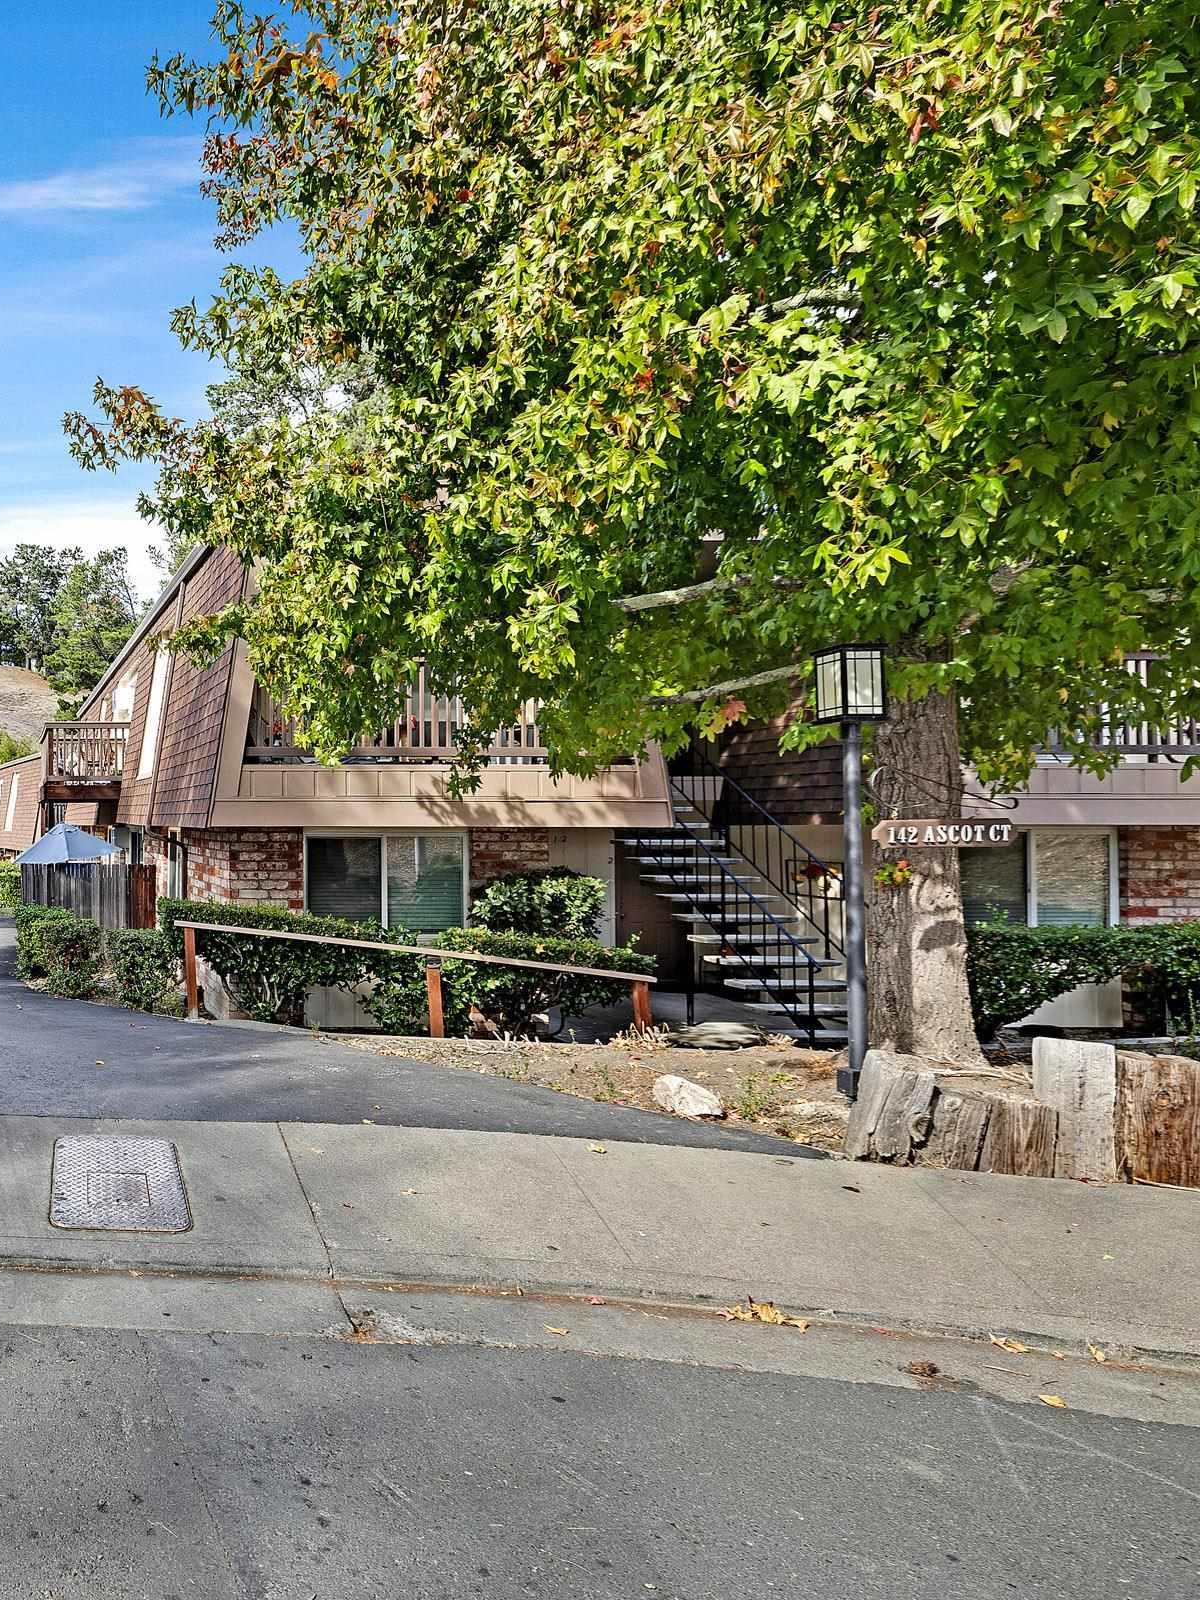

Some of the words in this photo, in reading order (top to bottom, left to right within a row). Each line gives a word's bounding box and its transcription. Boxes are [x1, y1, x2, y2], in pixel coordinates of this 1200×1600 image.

[888, 826, 918, 844] 142
[923, 825, 985, 843] ASCOT
[990, 825, 1011, 841] CT
